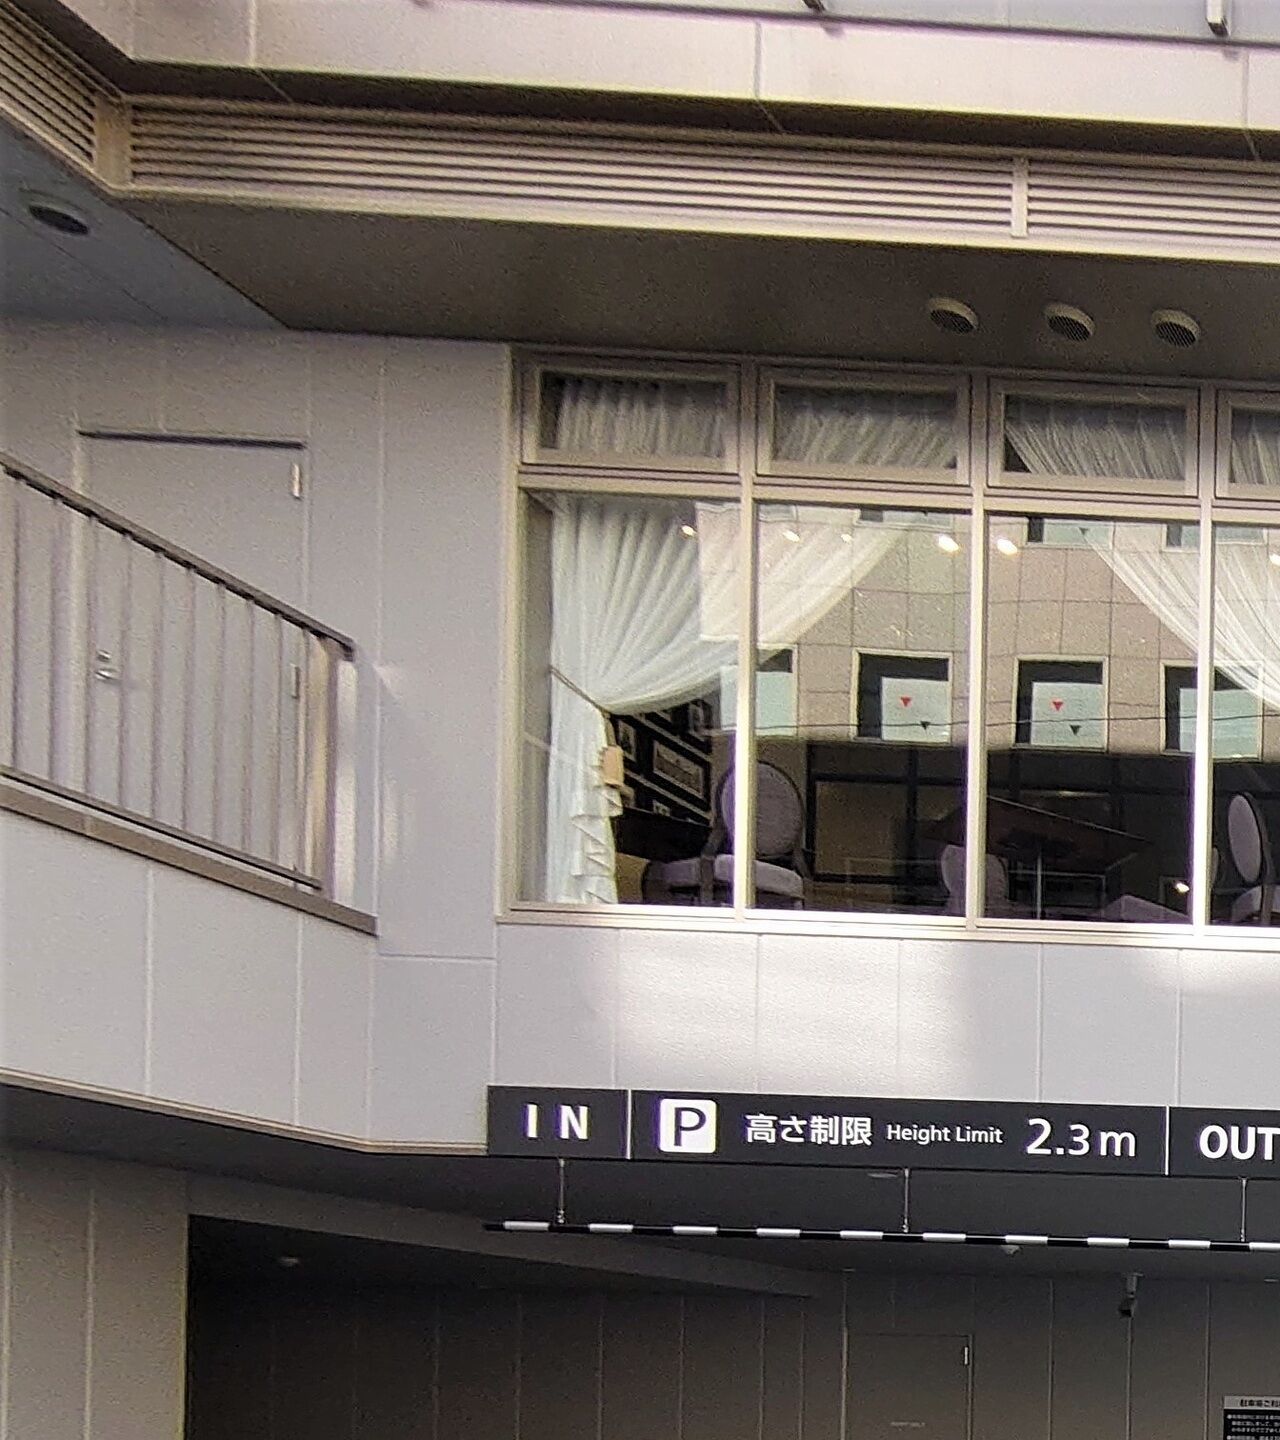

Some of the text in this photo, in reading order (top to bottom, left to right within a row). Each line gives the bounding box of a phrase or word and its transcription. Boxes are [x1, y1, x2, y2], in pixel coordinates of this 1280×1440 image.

[525, 1104, 590, 1140] IN
[744, 1112, 874, 1147] 高さ制限
[886, 1123, 952, 1146] Height
[955, 1124, 1004, 1144] Limit
[1199, 1124, 1280, 1161] OUT
